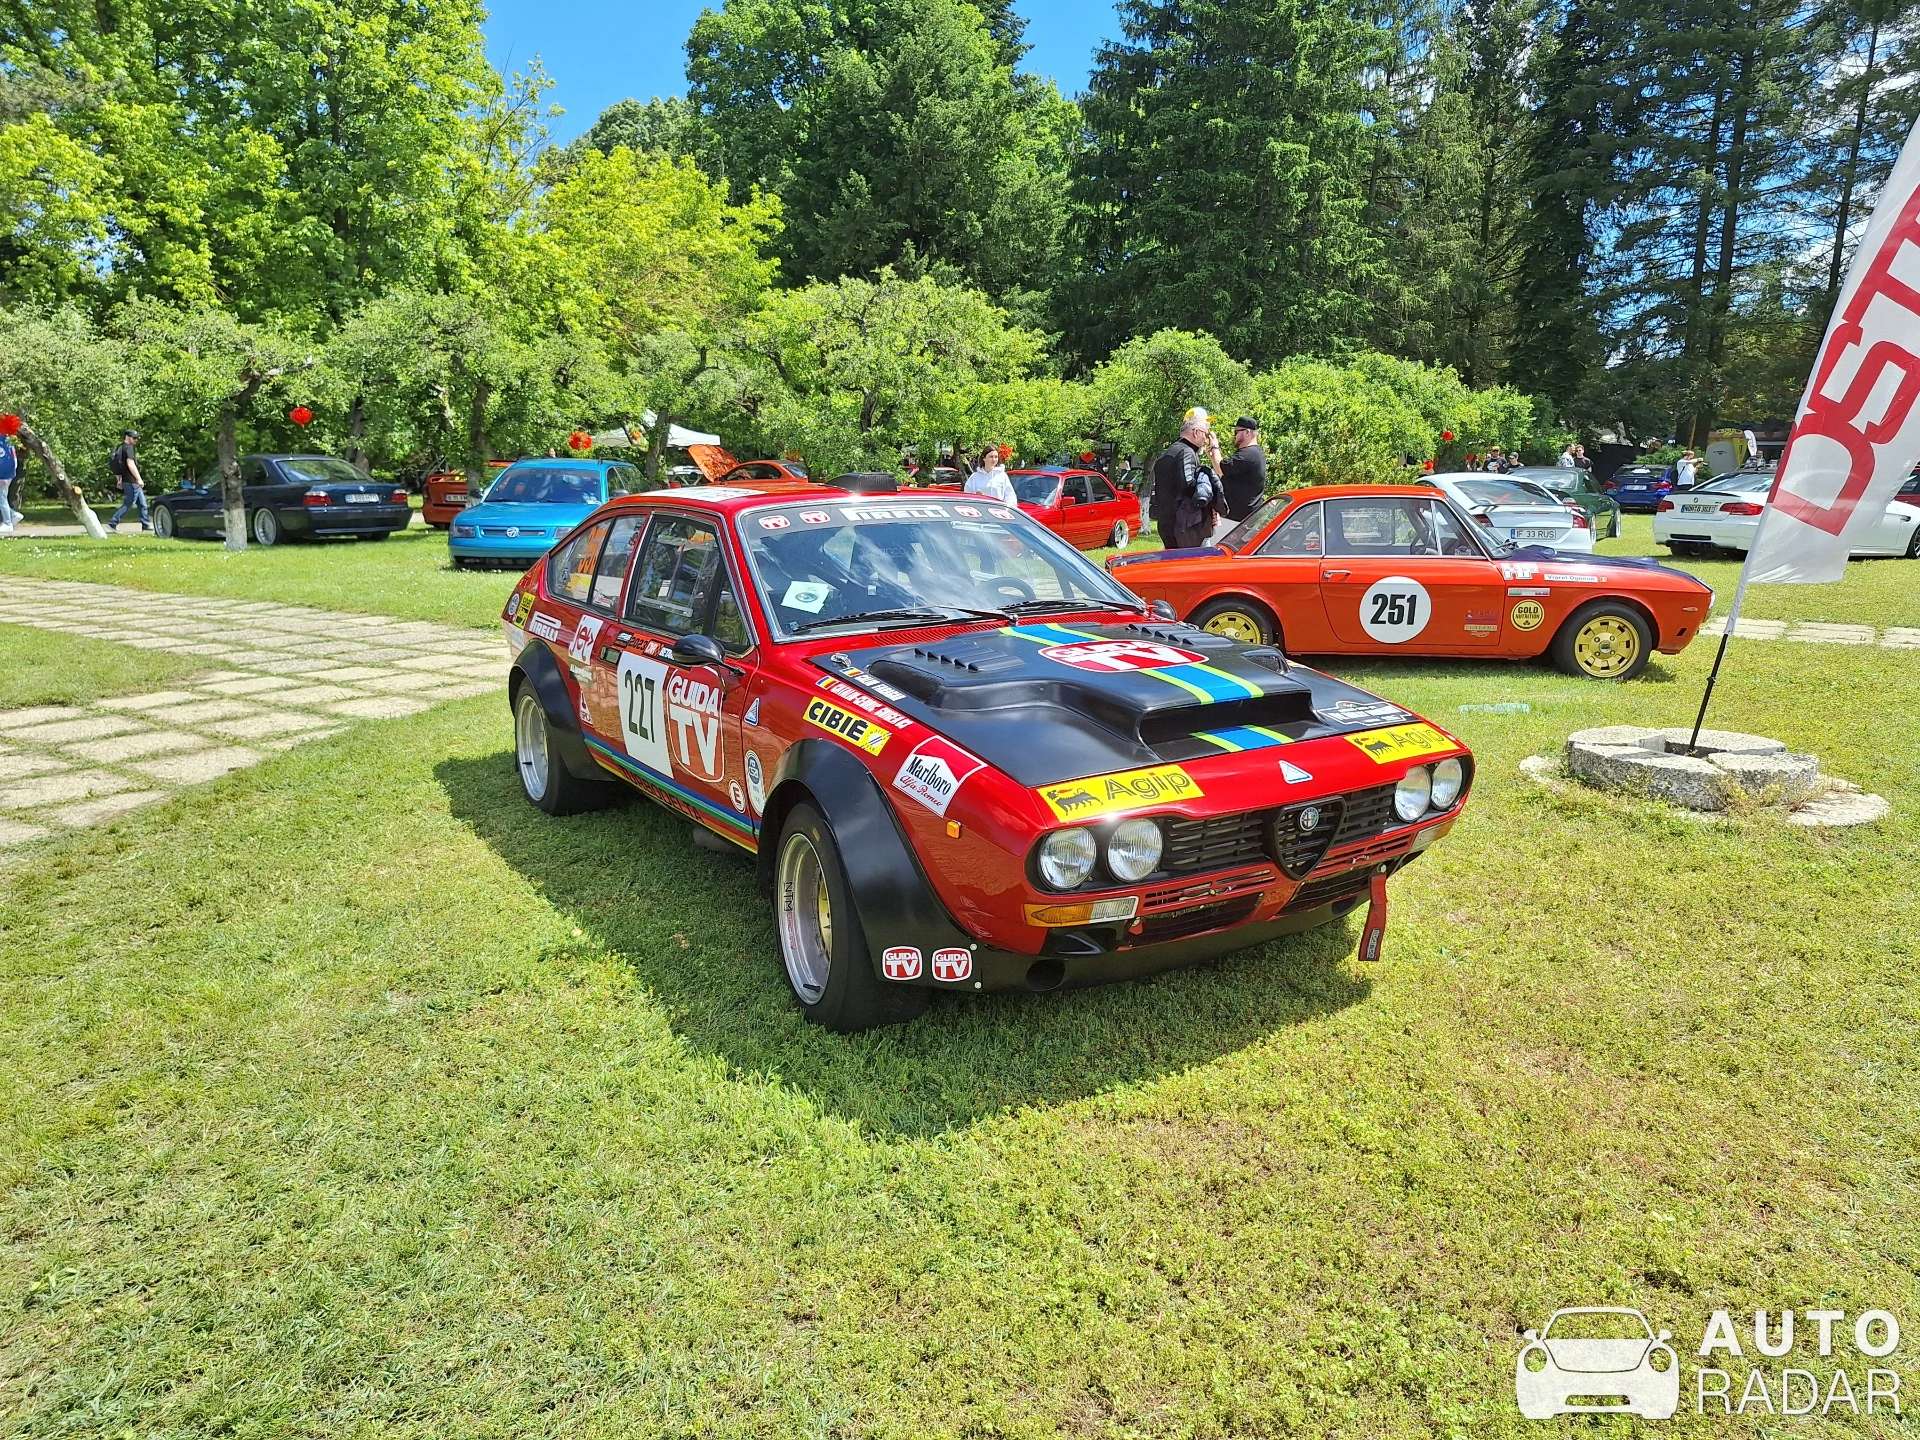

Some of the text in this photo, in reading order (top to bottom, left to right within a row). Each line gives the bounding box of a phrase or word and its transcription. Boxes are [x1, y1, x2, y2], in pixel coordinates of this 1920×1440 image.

[839, 505, 951, 521] PIRELLI
[1526, 530, 1536, 538] 33
[1537, 531, 1555, 539] RUS
[1370, 593, 1417, 625] 251
[1517, 606, 1539, 614] GOLD
[529, 611, 561, 642] PIRELLI
[1065, 647, 1192, 671] TV
[625, 669, 655, 744] 227
[668, 675, 719, 717] GUIDA
[669, 704, 719, 776] TV
[1386, 728, 1445, 749] Agip
[906, 756, 952, 796] Marlboro
[1104, 772, 1190, 800] Agip
[899, 775, 943, 807] Alfa Romeo
[784, 881, 794, 912] NTM
[885, 952, 918, 960] GUIDA
[886, 960, 918, 977] TV
[935, 953, 968, 962] GUIDA
[935, 961, 968, 978] TV
